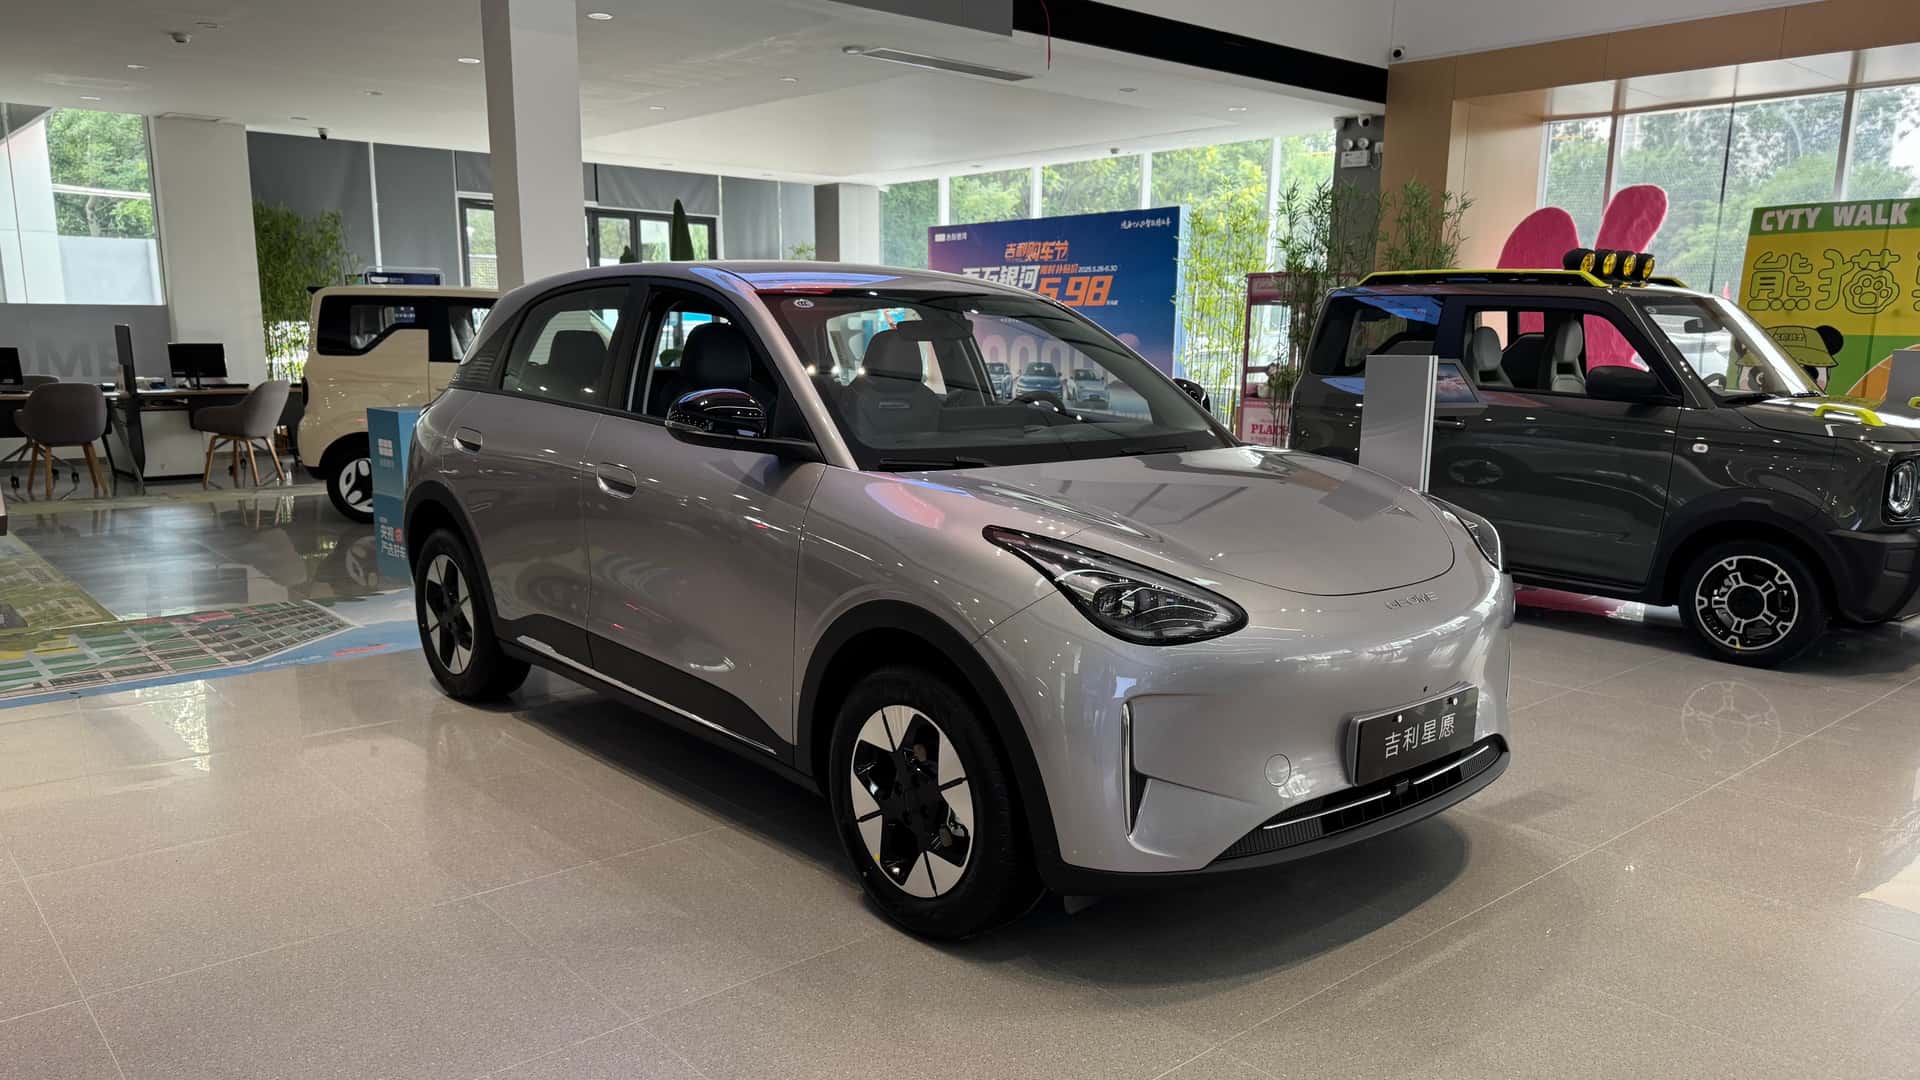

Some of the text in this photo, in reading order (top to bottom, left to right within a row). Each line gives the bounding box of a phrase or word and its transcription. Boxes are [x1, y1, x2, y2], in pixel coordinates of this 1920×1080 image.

[1761, 202, 1911, 231] CYTY WALK
[1004, 240, 1070, 262] 吉利购车节
[1038, 275, 1114, 307] 5.98
[1747, 248, 1920, 315] 熊猫
[1384, 712, 1456, 760] 吉利星愿
